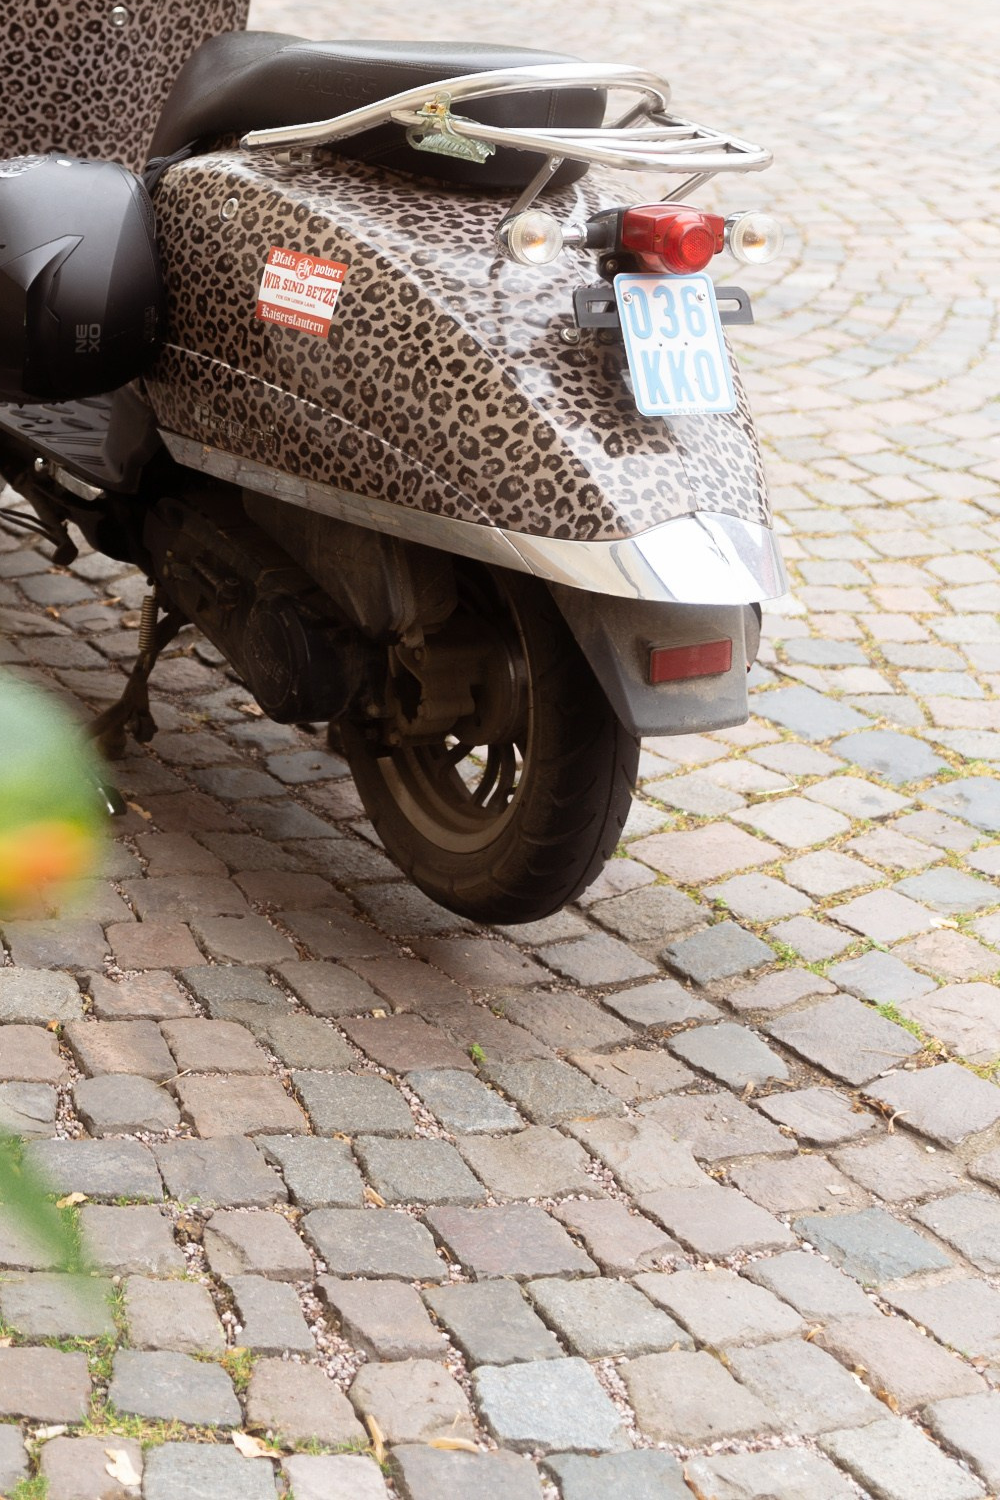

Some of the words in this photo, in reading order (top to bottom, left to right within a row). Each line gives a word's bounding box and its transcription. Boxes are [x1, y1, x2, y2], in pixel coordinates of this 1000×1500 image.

[272, 250, 296, 266] Pfalz
[314, 264, 342, 279] power
[263, 271, 281, 288] WIR
[282, 279, 304, 293] SIND
[306, 285, 338, 307] BETZE
[261, 304, 324, 333] Kaiserslautern
[628, 285, 707, 339] 036
[640, 350, 721, 405] KKO
